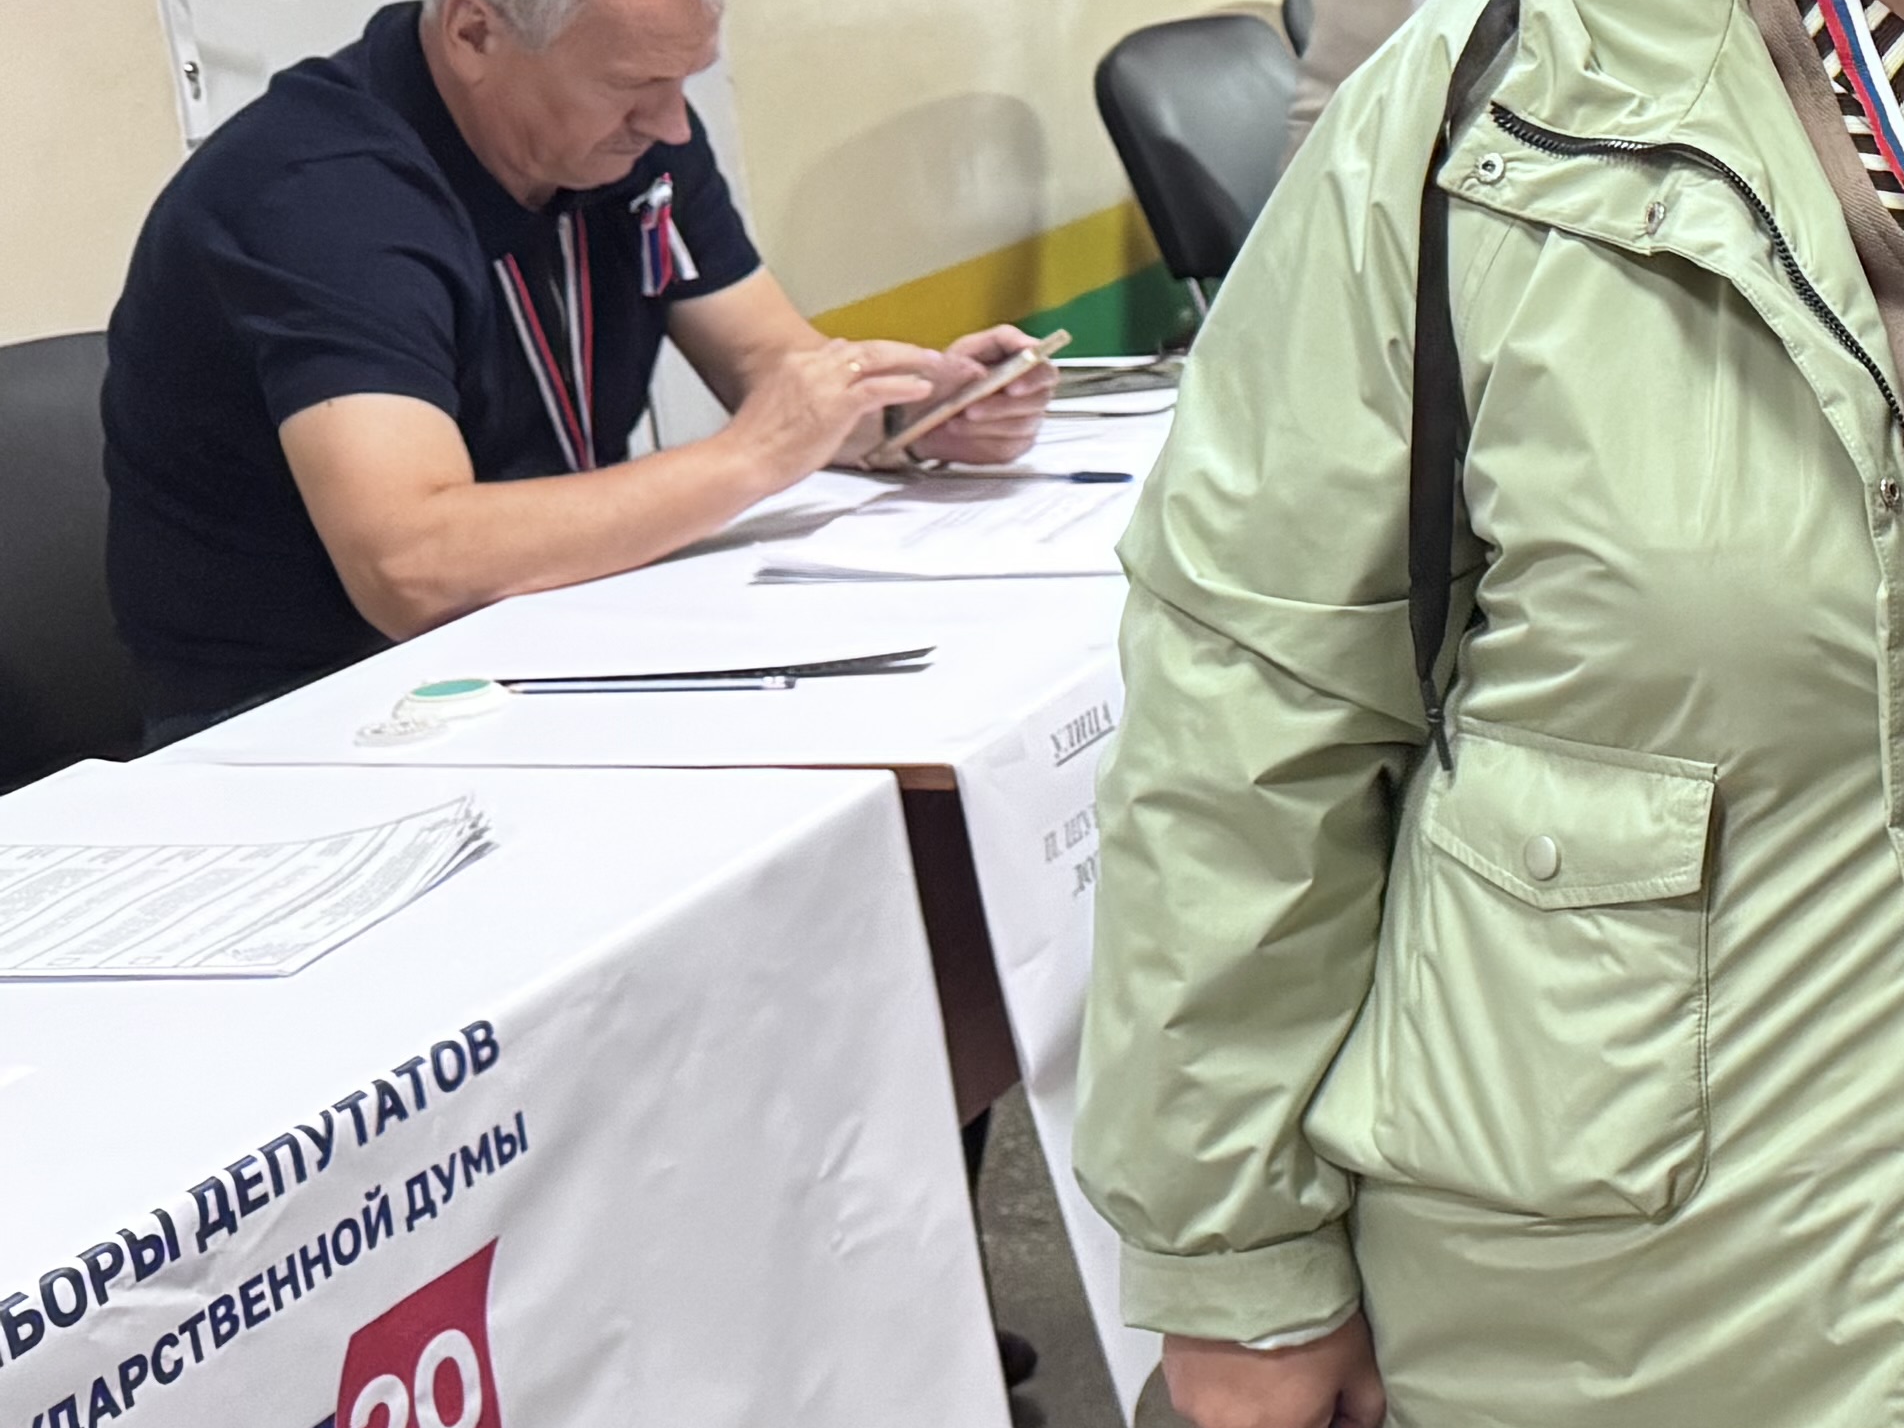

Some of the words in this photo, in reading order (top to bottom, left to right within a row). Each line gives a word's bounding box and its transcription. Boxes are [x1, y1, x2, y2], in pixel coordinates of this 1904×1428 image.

[0, 1208, 182, 1368] БОРЫ
[188, 1019, 502, 1255] ДЕПУТАТОВ
[406, 1109, 530, 1234] ДУМЫ
